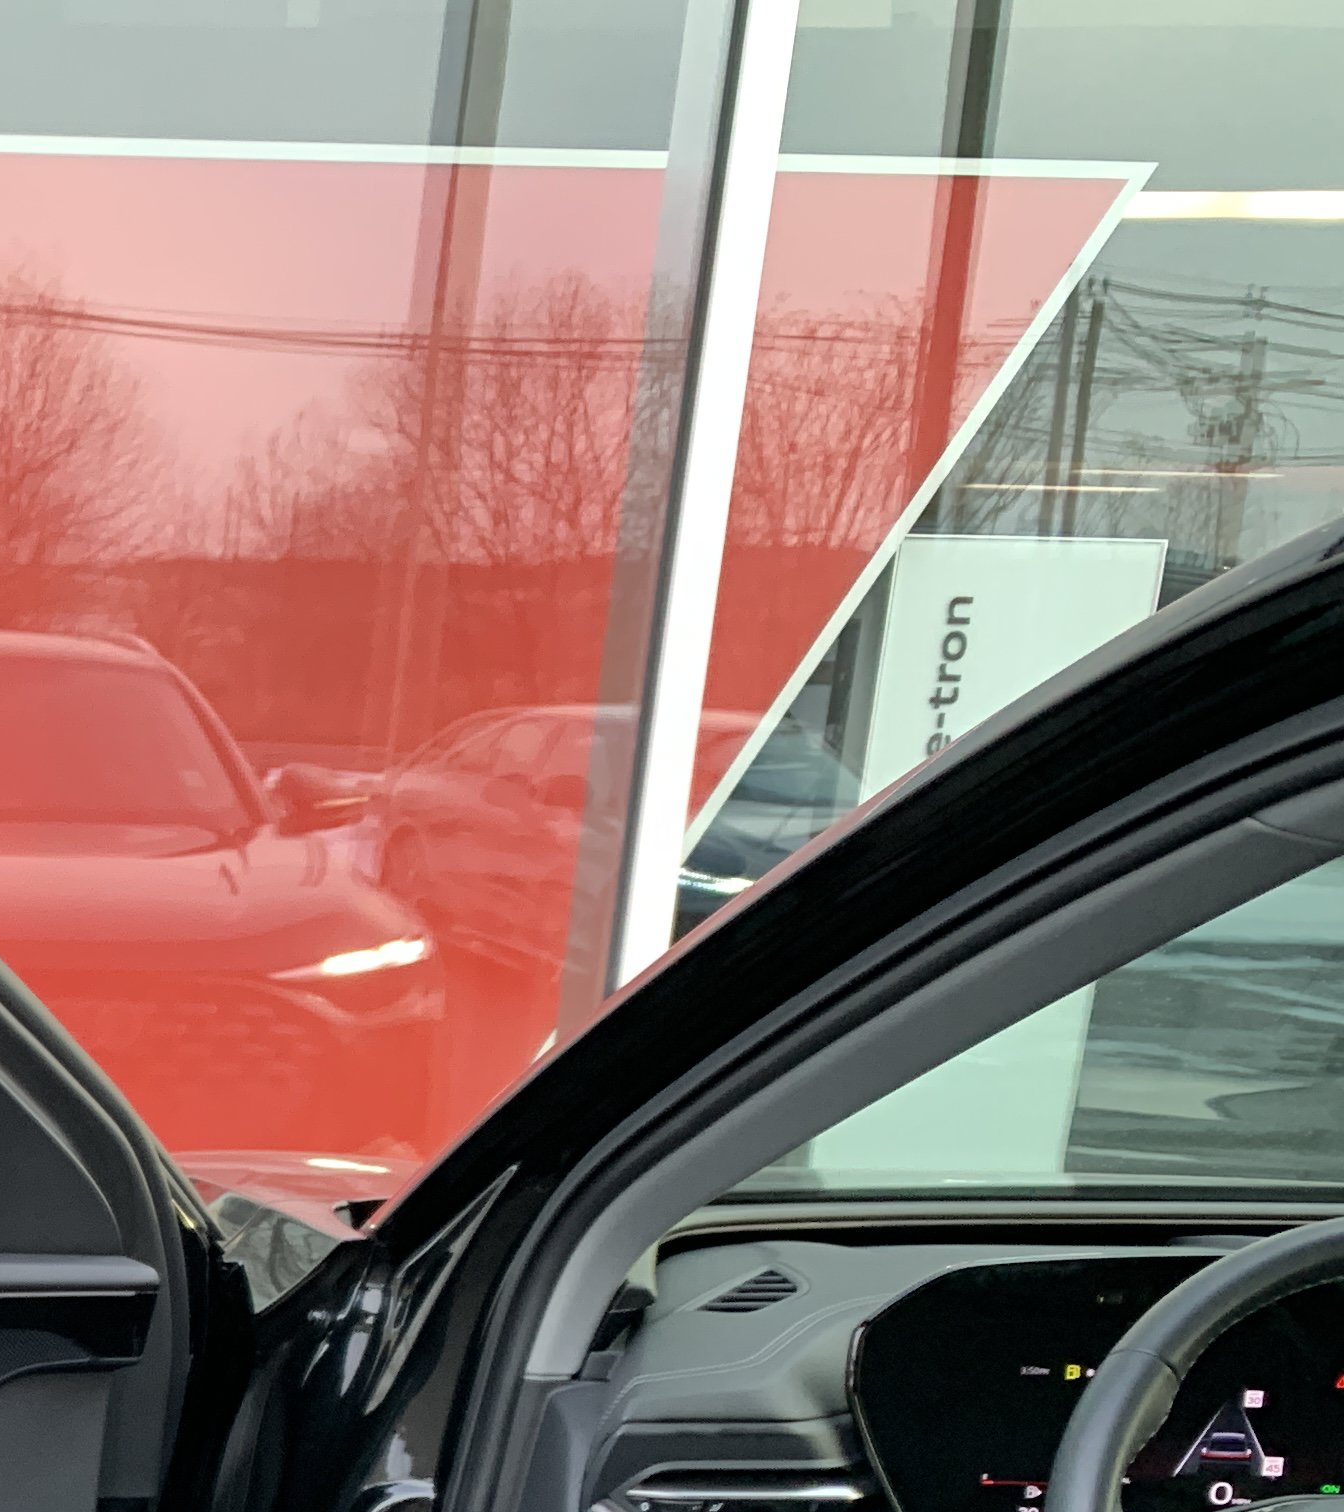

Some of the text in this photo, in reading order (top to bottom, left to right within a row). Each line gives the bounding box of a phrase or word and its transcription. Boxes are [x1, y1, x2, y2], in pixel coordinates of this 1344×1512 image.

[925, 595, 974, 756] e-tron
[1247, 1396, 1261, 1405] 30
[1265, 1464, 1281, 1473] 45
